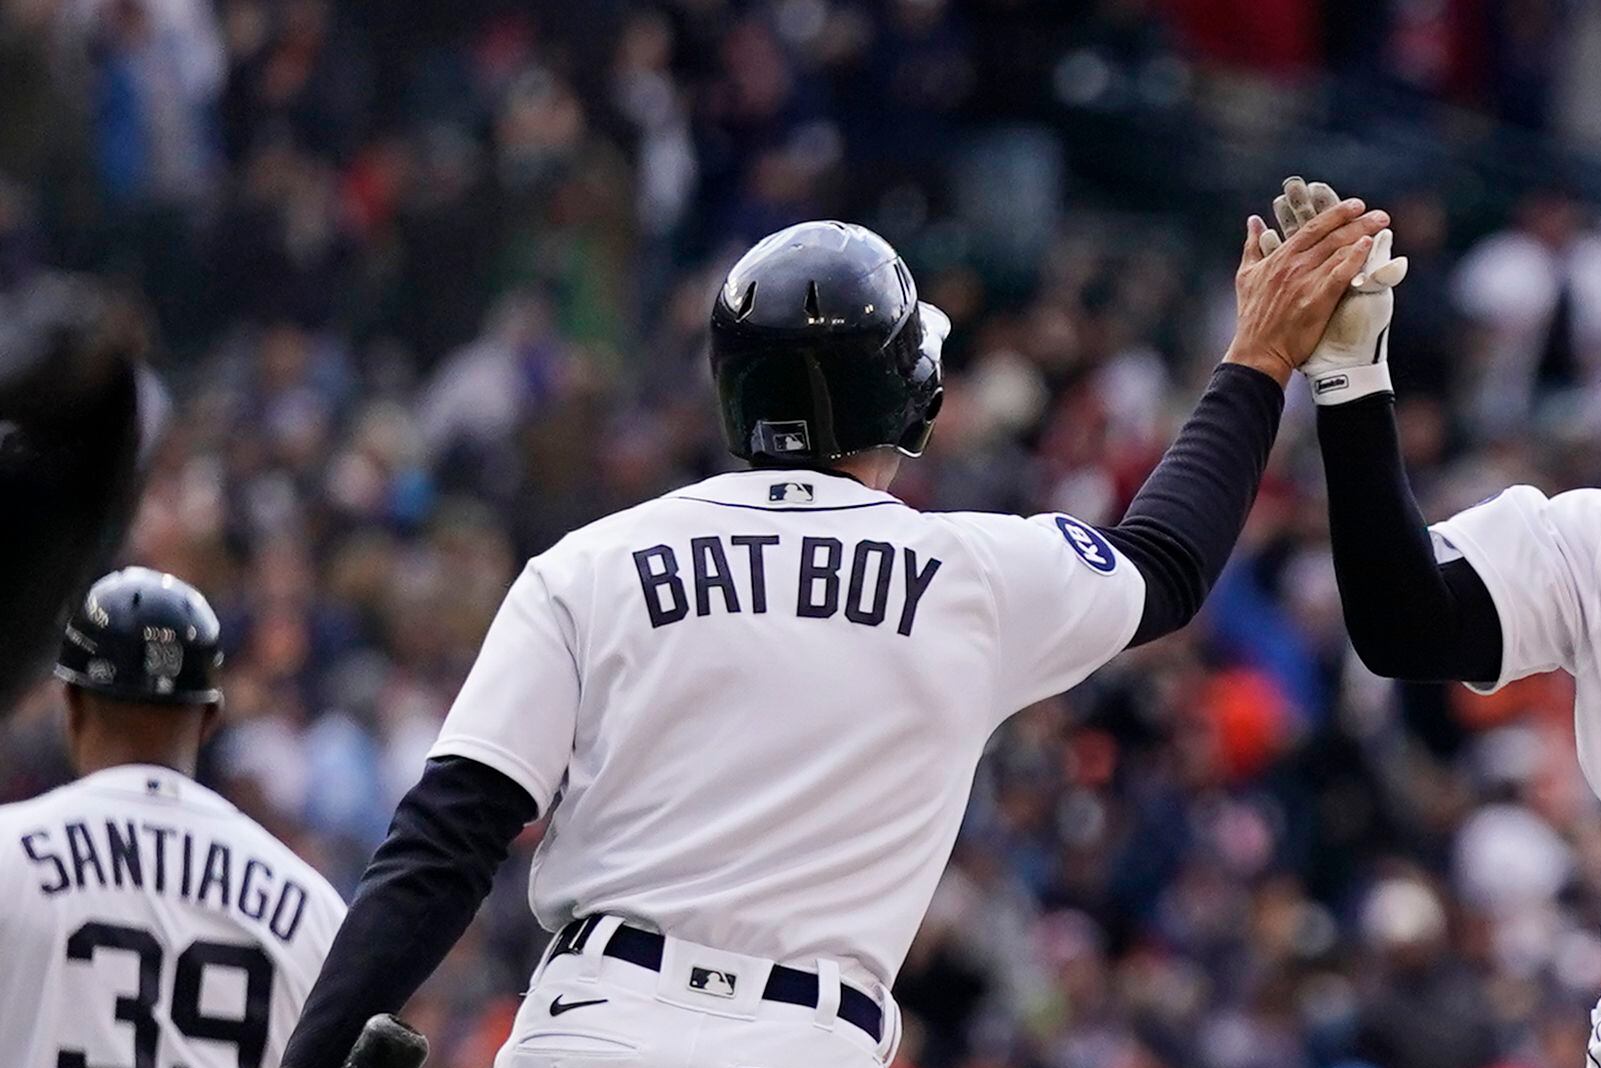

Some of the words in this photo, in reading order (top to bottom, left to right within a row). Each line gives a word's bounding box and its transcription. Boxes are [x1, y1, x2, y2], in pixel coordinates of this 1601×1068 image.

[633, 535, 780, 629] BAT
[796, 536, 943, 637] BOY
[1064, 523, 1107, 565] KB
[20, 820, 309, 942] SANTIAGO
